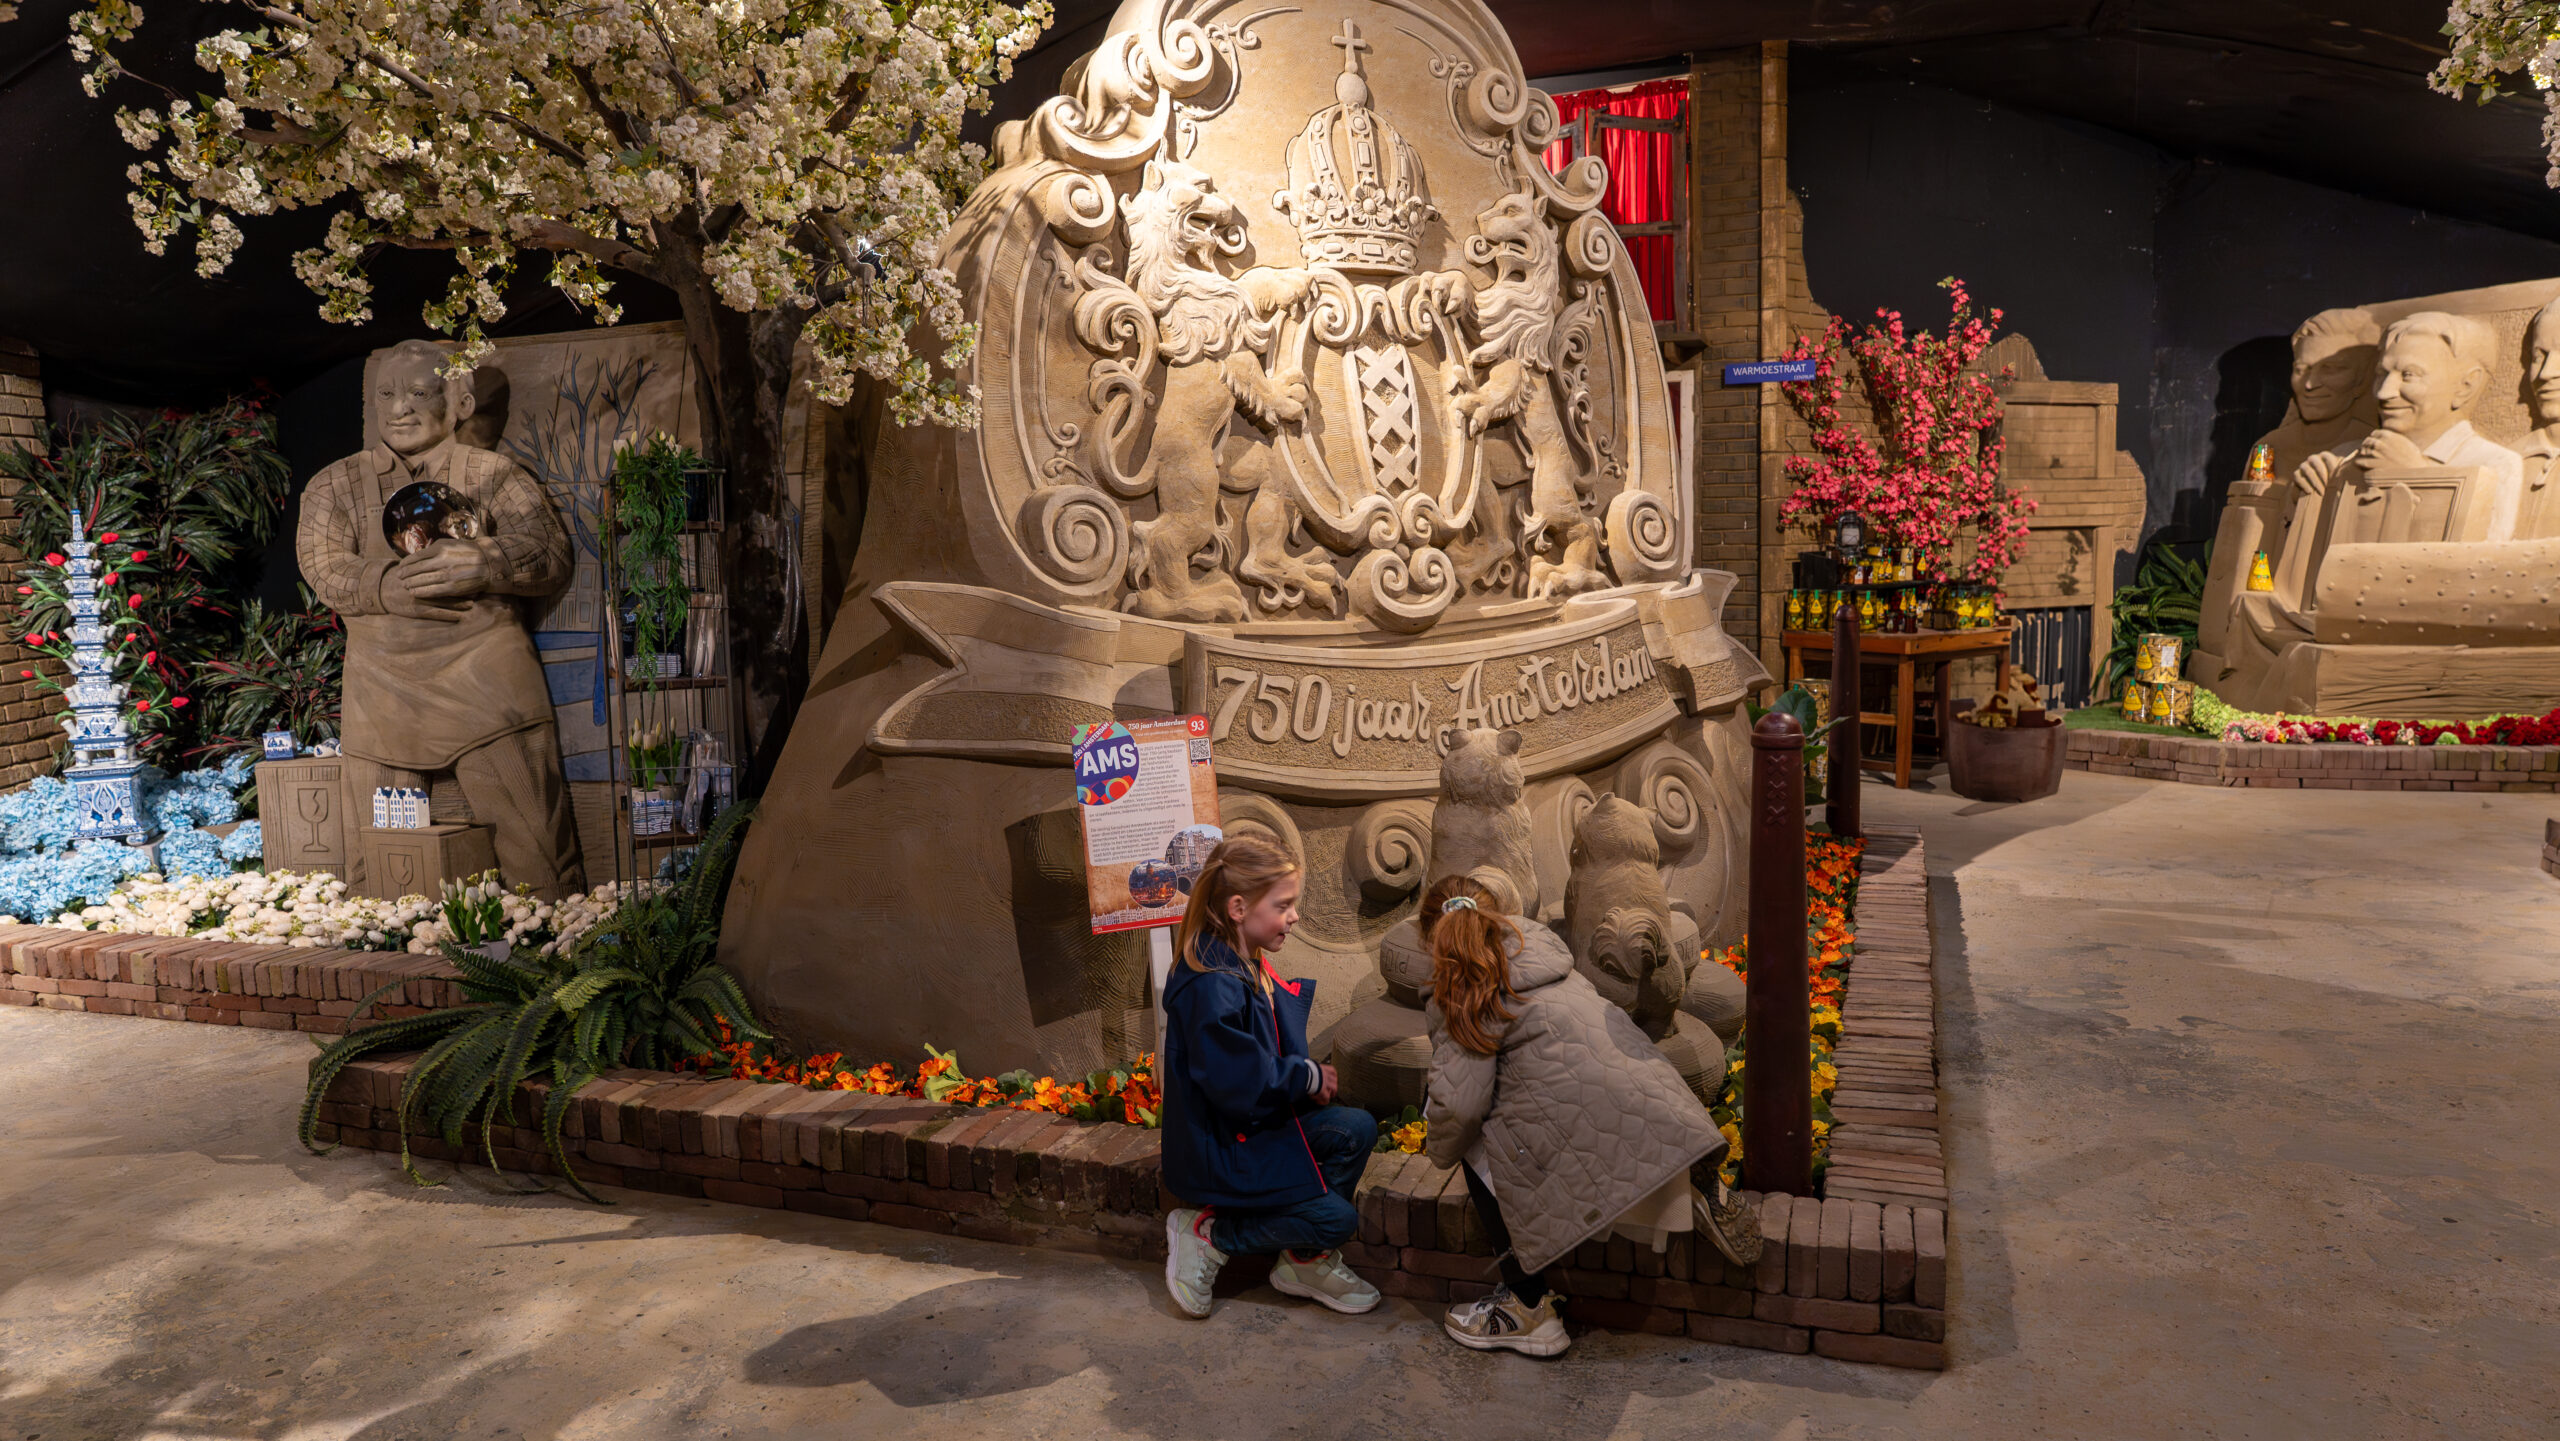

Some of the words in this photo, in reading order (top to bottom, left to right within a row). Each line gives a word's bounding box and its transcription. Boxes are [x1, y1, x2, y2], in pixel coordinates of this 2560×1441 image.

[1733, 363, 1806, 376] WARMOESTRAAT
[1212, 665, 1332, 744] 750
[1331, 681, 1431, 758] jaar
[1437, 636, 1657, 758] Amsterdam
[1128, 722, 1139, 730] 750
[1153, 719, 1186, 728] Amsterdam
[1191, 720, 1205, 732] 93
[1084, 722, 1109, 750] AMSTERDAM
[1083, 743, 1138, 777] AMS
